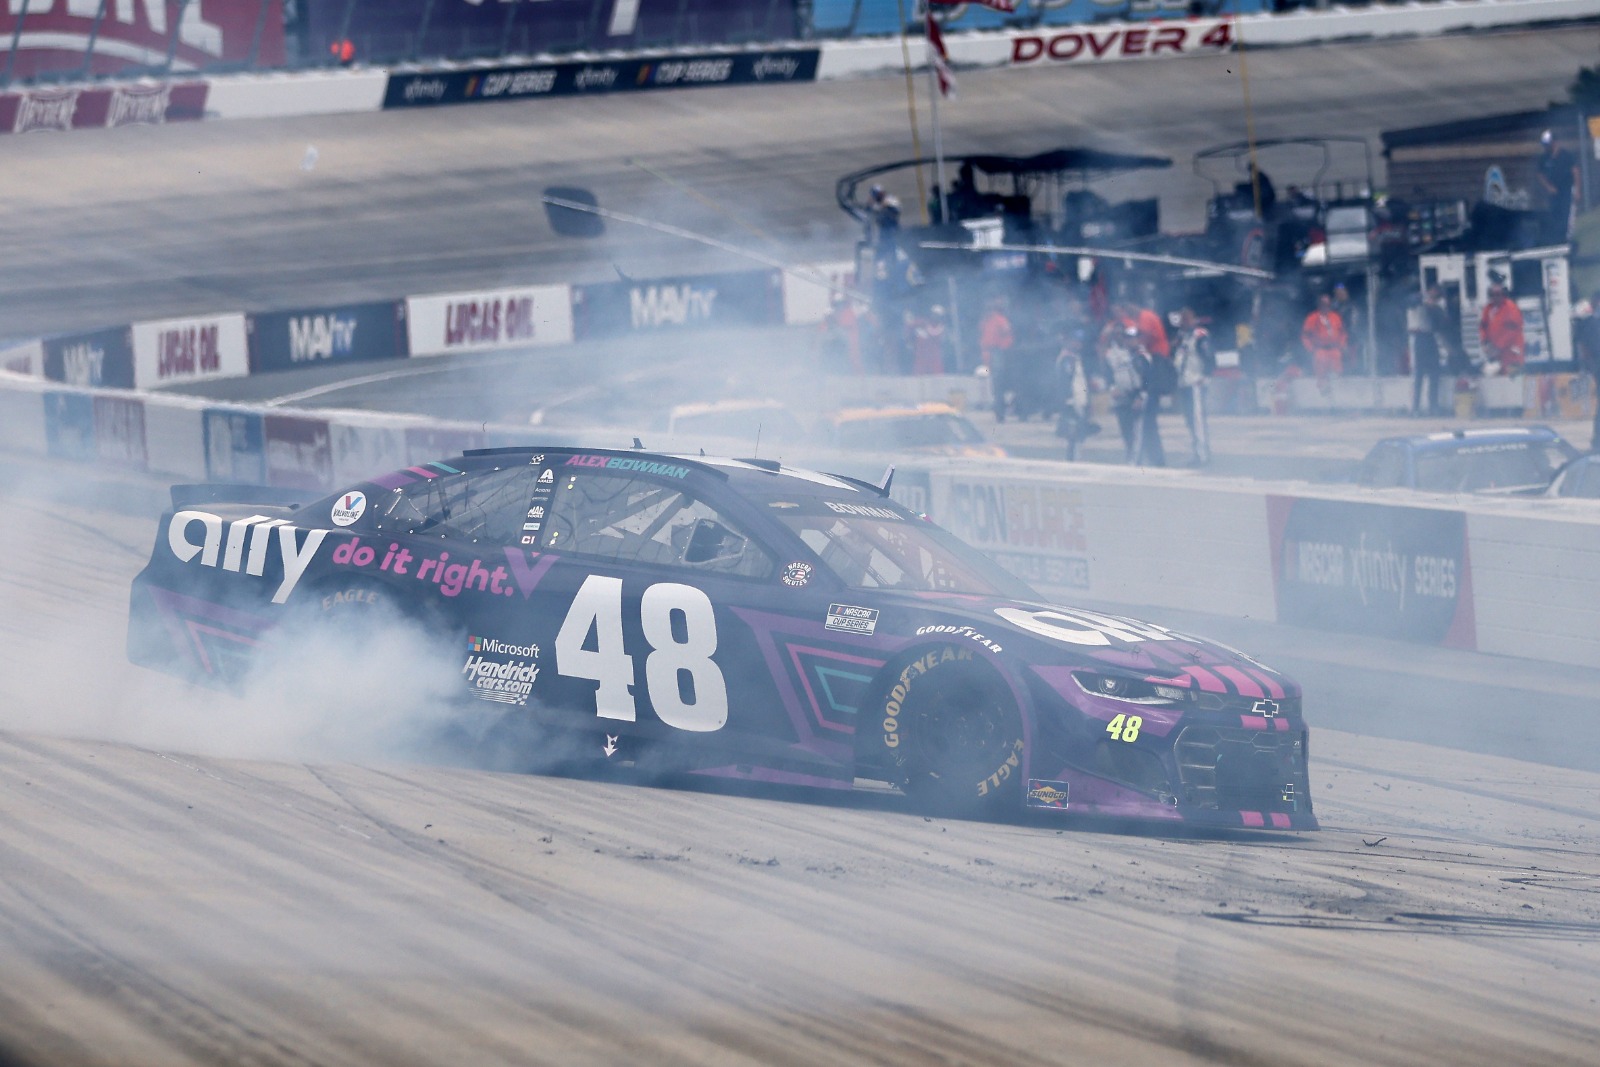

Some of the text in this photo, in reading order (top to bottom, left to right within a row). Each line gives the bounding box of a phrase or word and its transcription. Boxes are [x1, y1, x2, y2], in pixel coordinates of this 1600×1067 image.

[1011, 24, 1236, 63] DOVER 4
[333, 509, 360, 520] VALVOLINE
[823, 501, 905, 521] BOWMAN
[168, 511, 331, 604] ally
[332, 537, 514, 597] do it right.
[788, 562, 812, 573] NASCAR
[782, 575, 808, 587] SALUTES
[1349, 531, 1408, 612] xfinity
[1414, 555, 1457, 599] SERIES
[321, 589, 380, 610] EAGLE
[832, 617, 870, 629] CUP SERIES
[843, 607, 872, 619] NASCAR
[482, 638, 540, 659] Microsoft
[916, 625, 1003, 653] GOODYEAR
[554, 574, 729, 733] 48
[461, 655, 540, 683] Hendrick
[476, 676, 533, 694] cars.com
[883, 646, 974, 748] GOODYEAR
[1105, 713, 1143, 743] 48
[976, 738, 1025, 797] EAGLE
[1031, 790, 1068, 799] SUNOCO
